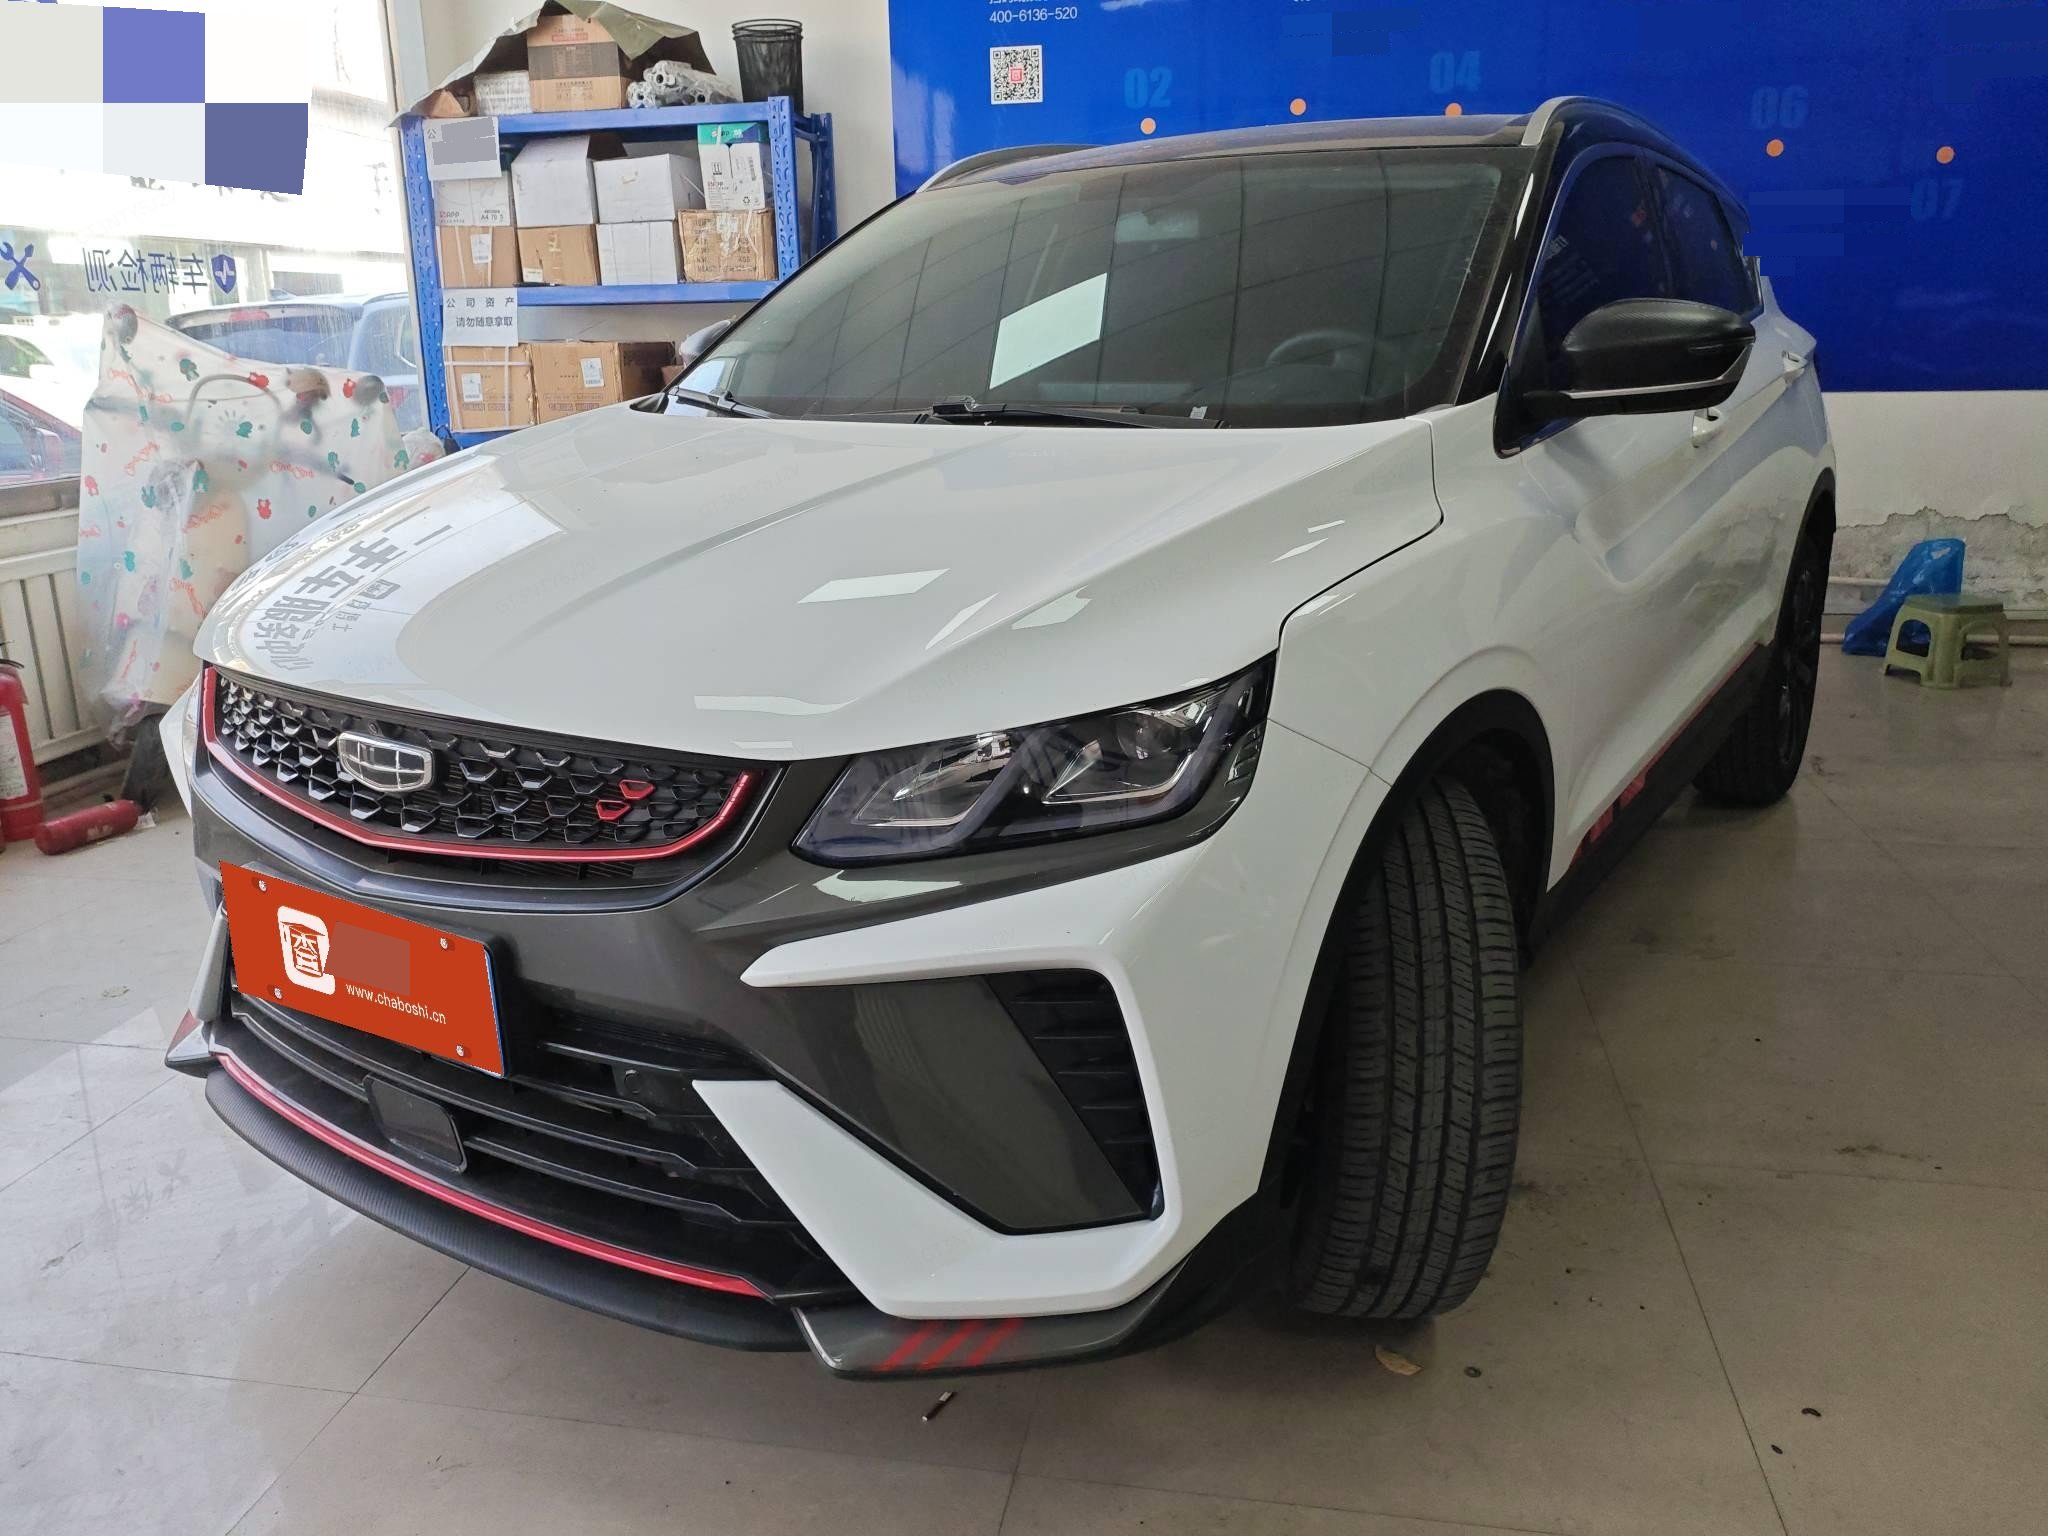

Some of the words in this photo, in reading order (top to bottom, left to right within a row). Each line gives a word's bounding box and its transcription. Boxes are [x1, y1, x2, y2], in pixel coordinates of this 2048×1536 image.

[989, 6, 1078, 23] 400-6136-520
[1124, 67, 1172, 109] 02
[1429, 50, 1482, 94] 04
[1910, 178, 1963, 220] 07
[456, 316, 513, 328] 请勿随意拿取
